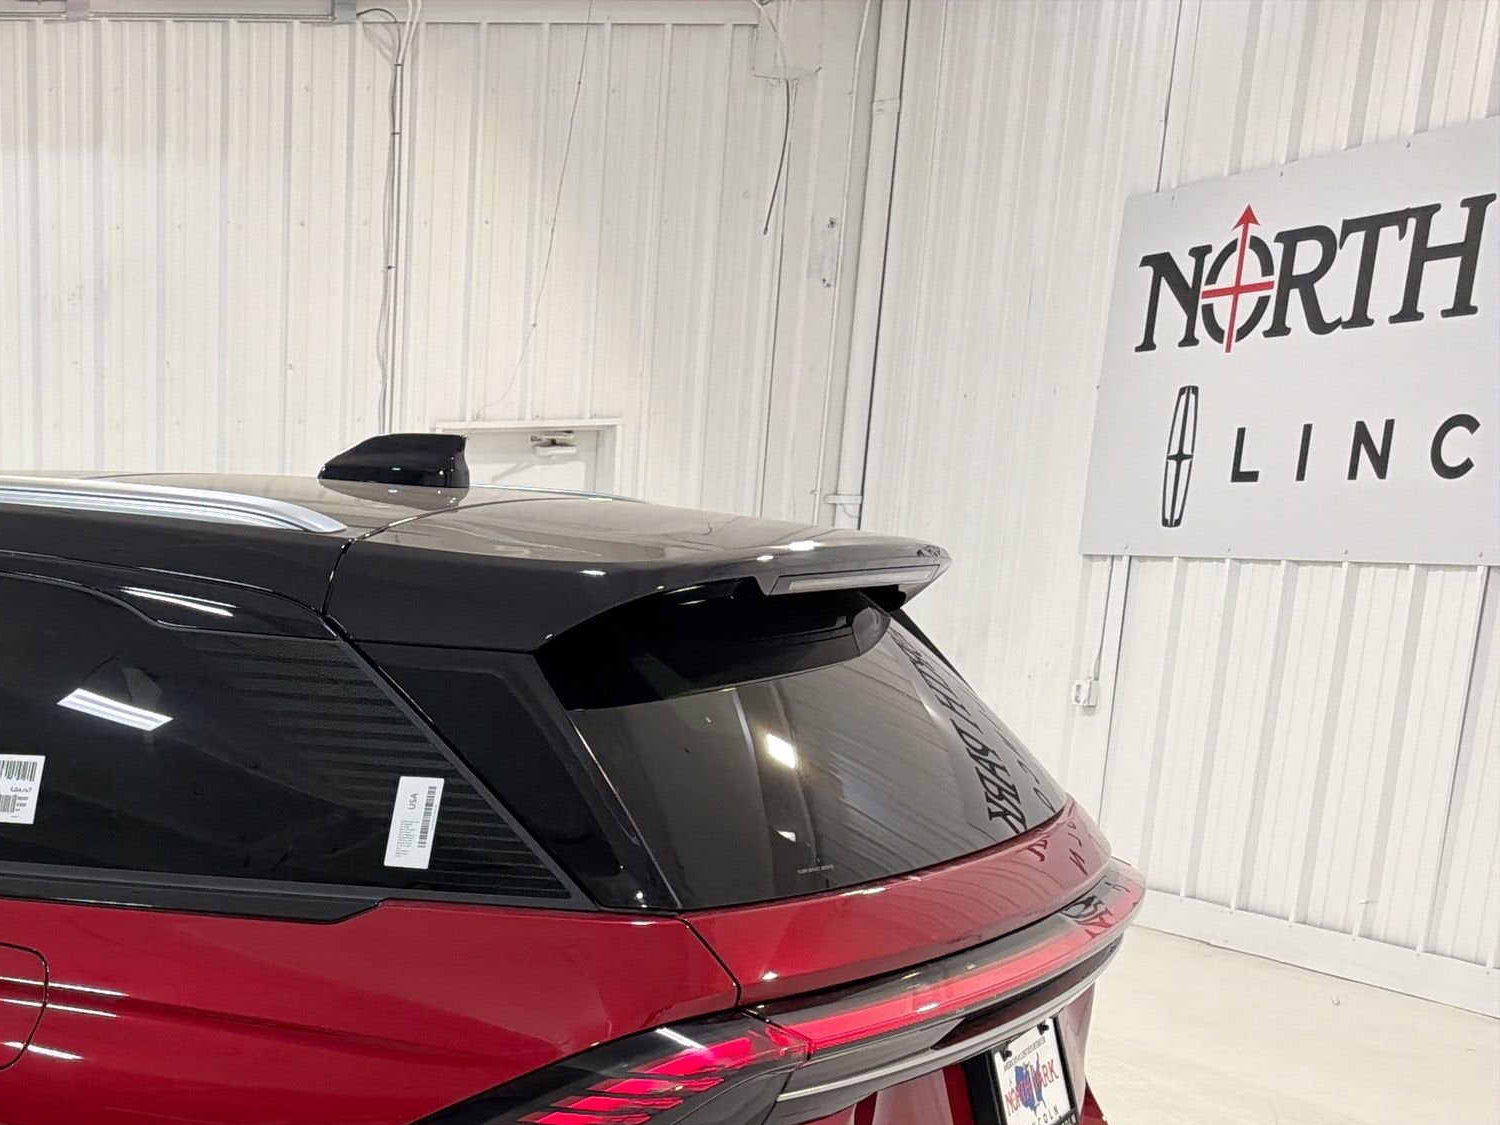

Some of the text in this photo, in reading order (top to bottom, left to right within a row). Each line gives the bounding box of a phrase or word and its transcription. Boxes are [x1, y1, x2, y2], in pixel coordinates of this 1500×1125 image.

[1134, 192, 1497, 353] NORTH
[408, 792, 418, 810] USA
[1030, 1059, 1059, 1096] PARK
